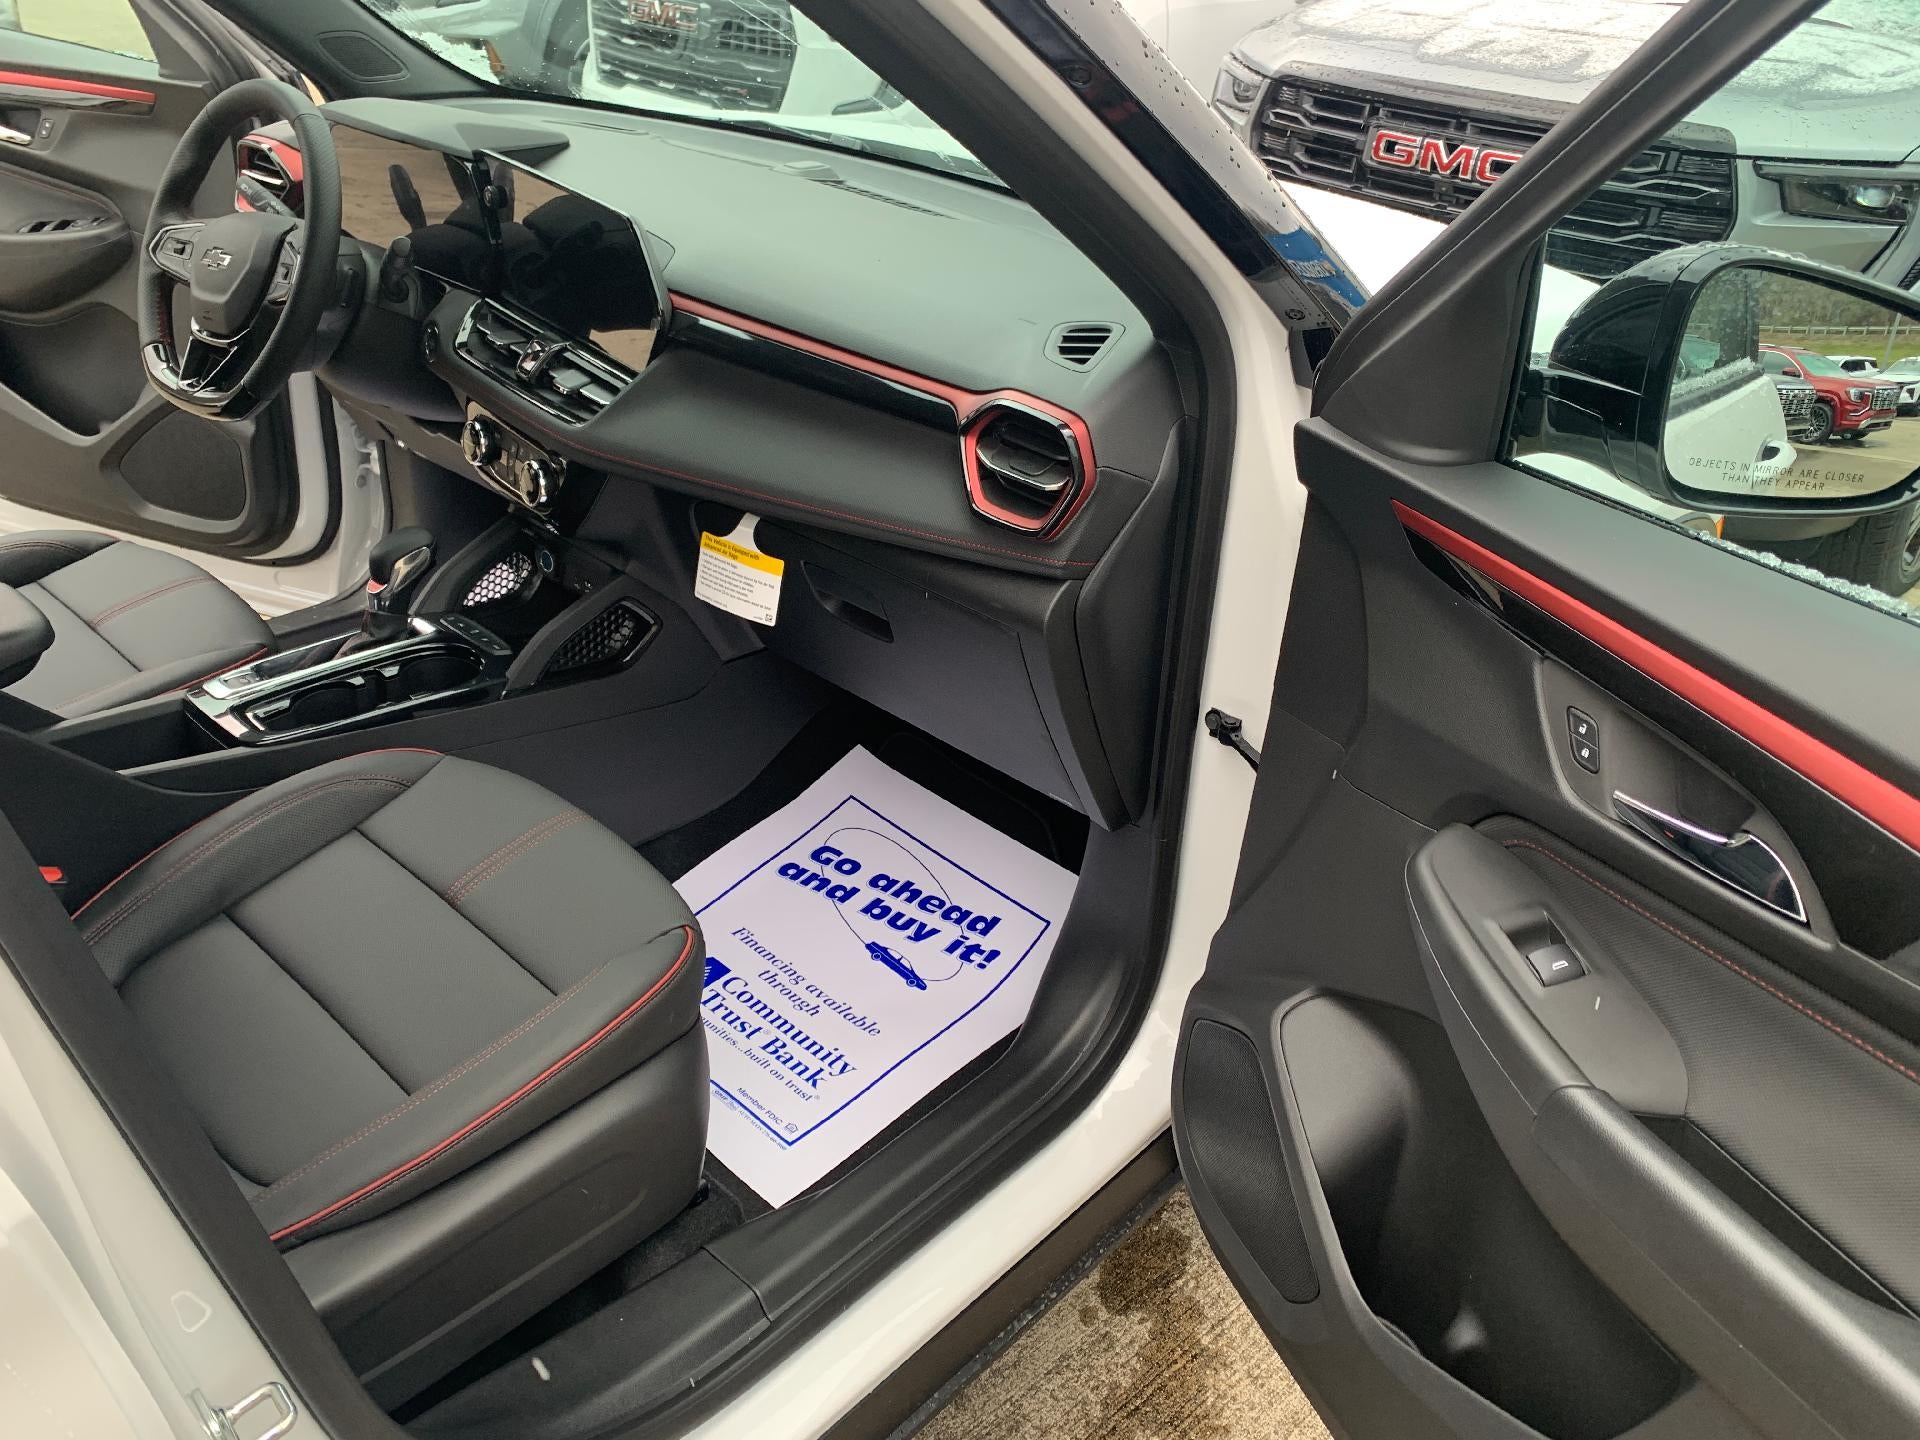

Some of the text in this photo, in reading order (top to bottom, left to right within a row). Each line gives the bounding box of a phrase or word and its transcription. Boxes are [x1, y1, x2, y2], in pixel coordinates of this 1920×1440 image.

[628, 0, 698, 32] GMC
[1371, 130, 1523, 183] GMC
[1688, 457, 1865, 483] OBJECTS IN MIRROR ARE CLOSER
[1722, 472, 1826, 491] THAN THEY APPEAR
[776, 862, 1002, 970] and buy it!
[810, 845, 1002, 937] Go ahead
[731, 926, 881, 1037] Financing available
[757, 969, 821, 1018] through
[721, 975, 858, 1077] Community
[759, 1035, 828, 1090] Bank
[769, 1069, 785, 1081] on
[736, 1086, 766, 1112] Member
[765, 1109, 783, 1126] FDIC
